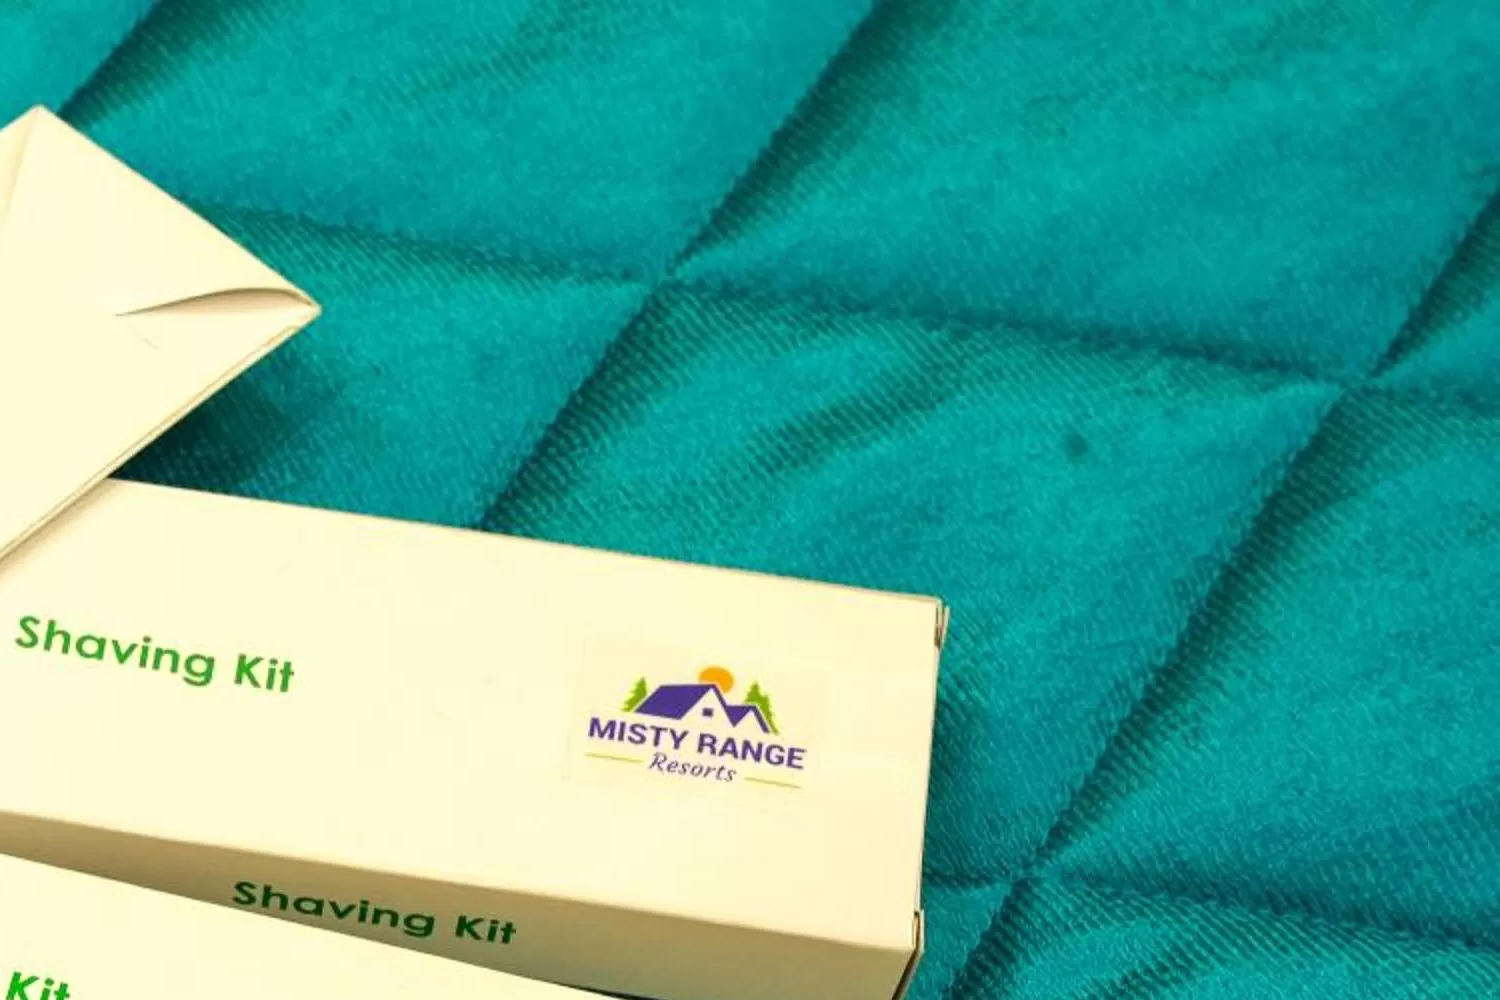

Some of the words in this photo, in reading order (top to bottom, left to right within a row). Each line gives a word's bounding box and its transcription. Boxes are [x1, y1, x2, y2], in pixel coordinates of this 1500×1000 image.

[14, 615, 215, 687] Shaving
[234, 654, 294, 692] Kit
[588, 717, 688, 750] MISTY
[697, 733, 807, 770] RANGE
[648, 752, 737, 782] Resorts
[232, 881, 436, 937] Shaving
[455, 915, 516, 944] Kit
